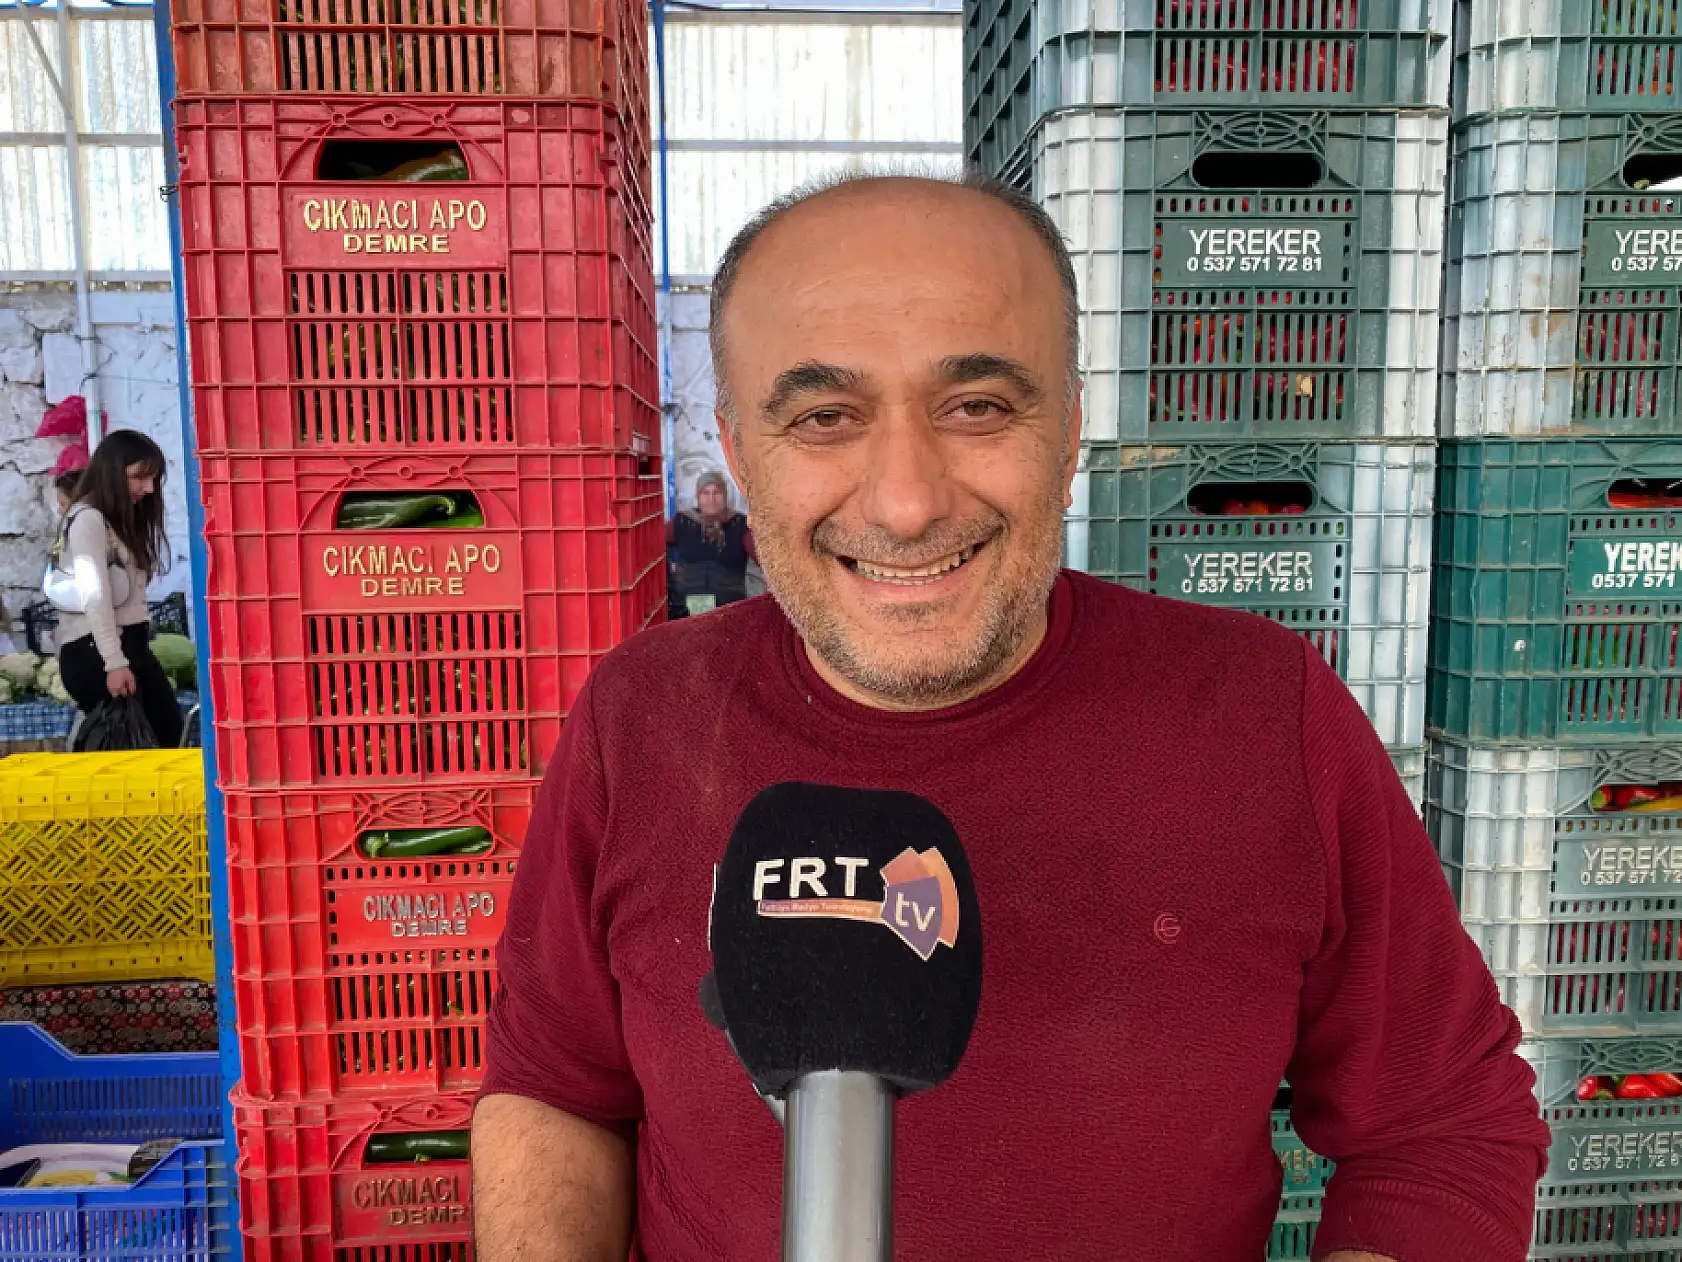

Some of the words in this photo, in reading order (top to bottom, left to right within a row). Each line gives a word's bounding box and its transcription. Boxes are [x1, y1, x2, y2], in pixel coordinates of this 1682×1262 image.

[430, 199, 487, 230] APO
[343, 233, 450, 253] DEMRE
[1188, 228, 1322, 255] YEREKER
[1186, 256, 1199, 271] 0
[1203, 257, 1235, 272] 537
[1240, 257, 1271, 272] 571
[1277, 257, 1298, 272] 72
[1302, 257, 1322, 271] 81
[1611, 257, 1622, 271] 0
[1626, 257, 1659, 271] 537
[445, 543, 501, 573] APO
[1184, 551, 1313, 578] YEREKER
[361, 576, 465, 597] DEMRE
[1181, 579, 1193, 593] 0
[1197, 577, 1229, 593] 537
[1233, 577, 1263, 593] 571
[1269, 577, 1290, 592] 72
[1294, 576, 1313, 592] 81
[1592, 572, 1638, 588] 0537
[1643, 571, 1676, 588] 571
[752, 856, 869, 900] FRT
[1580, 871, 1591, 886] 0
[453, 891, 495, 917] APO
[895, 892, 936, 932] tv
[391, 918, 468, 937] DEMRE
